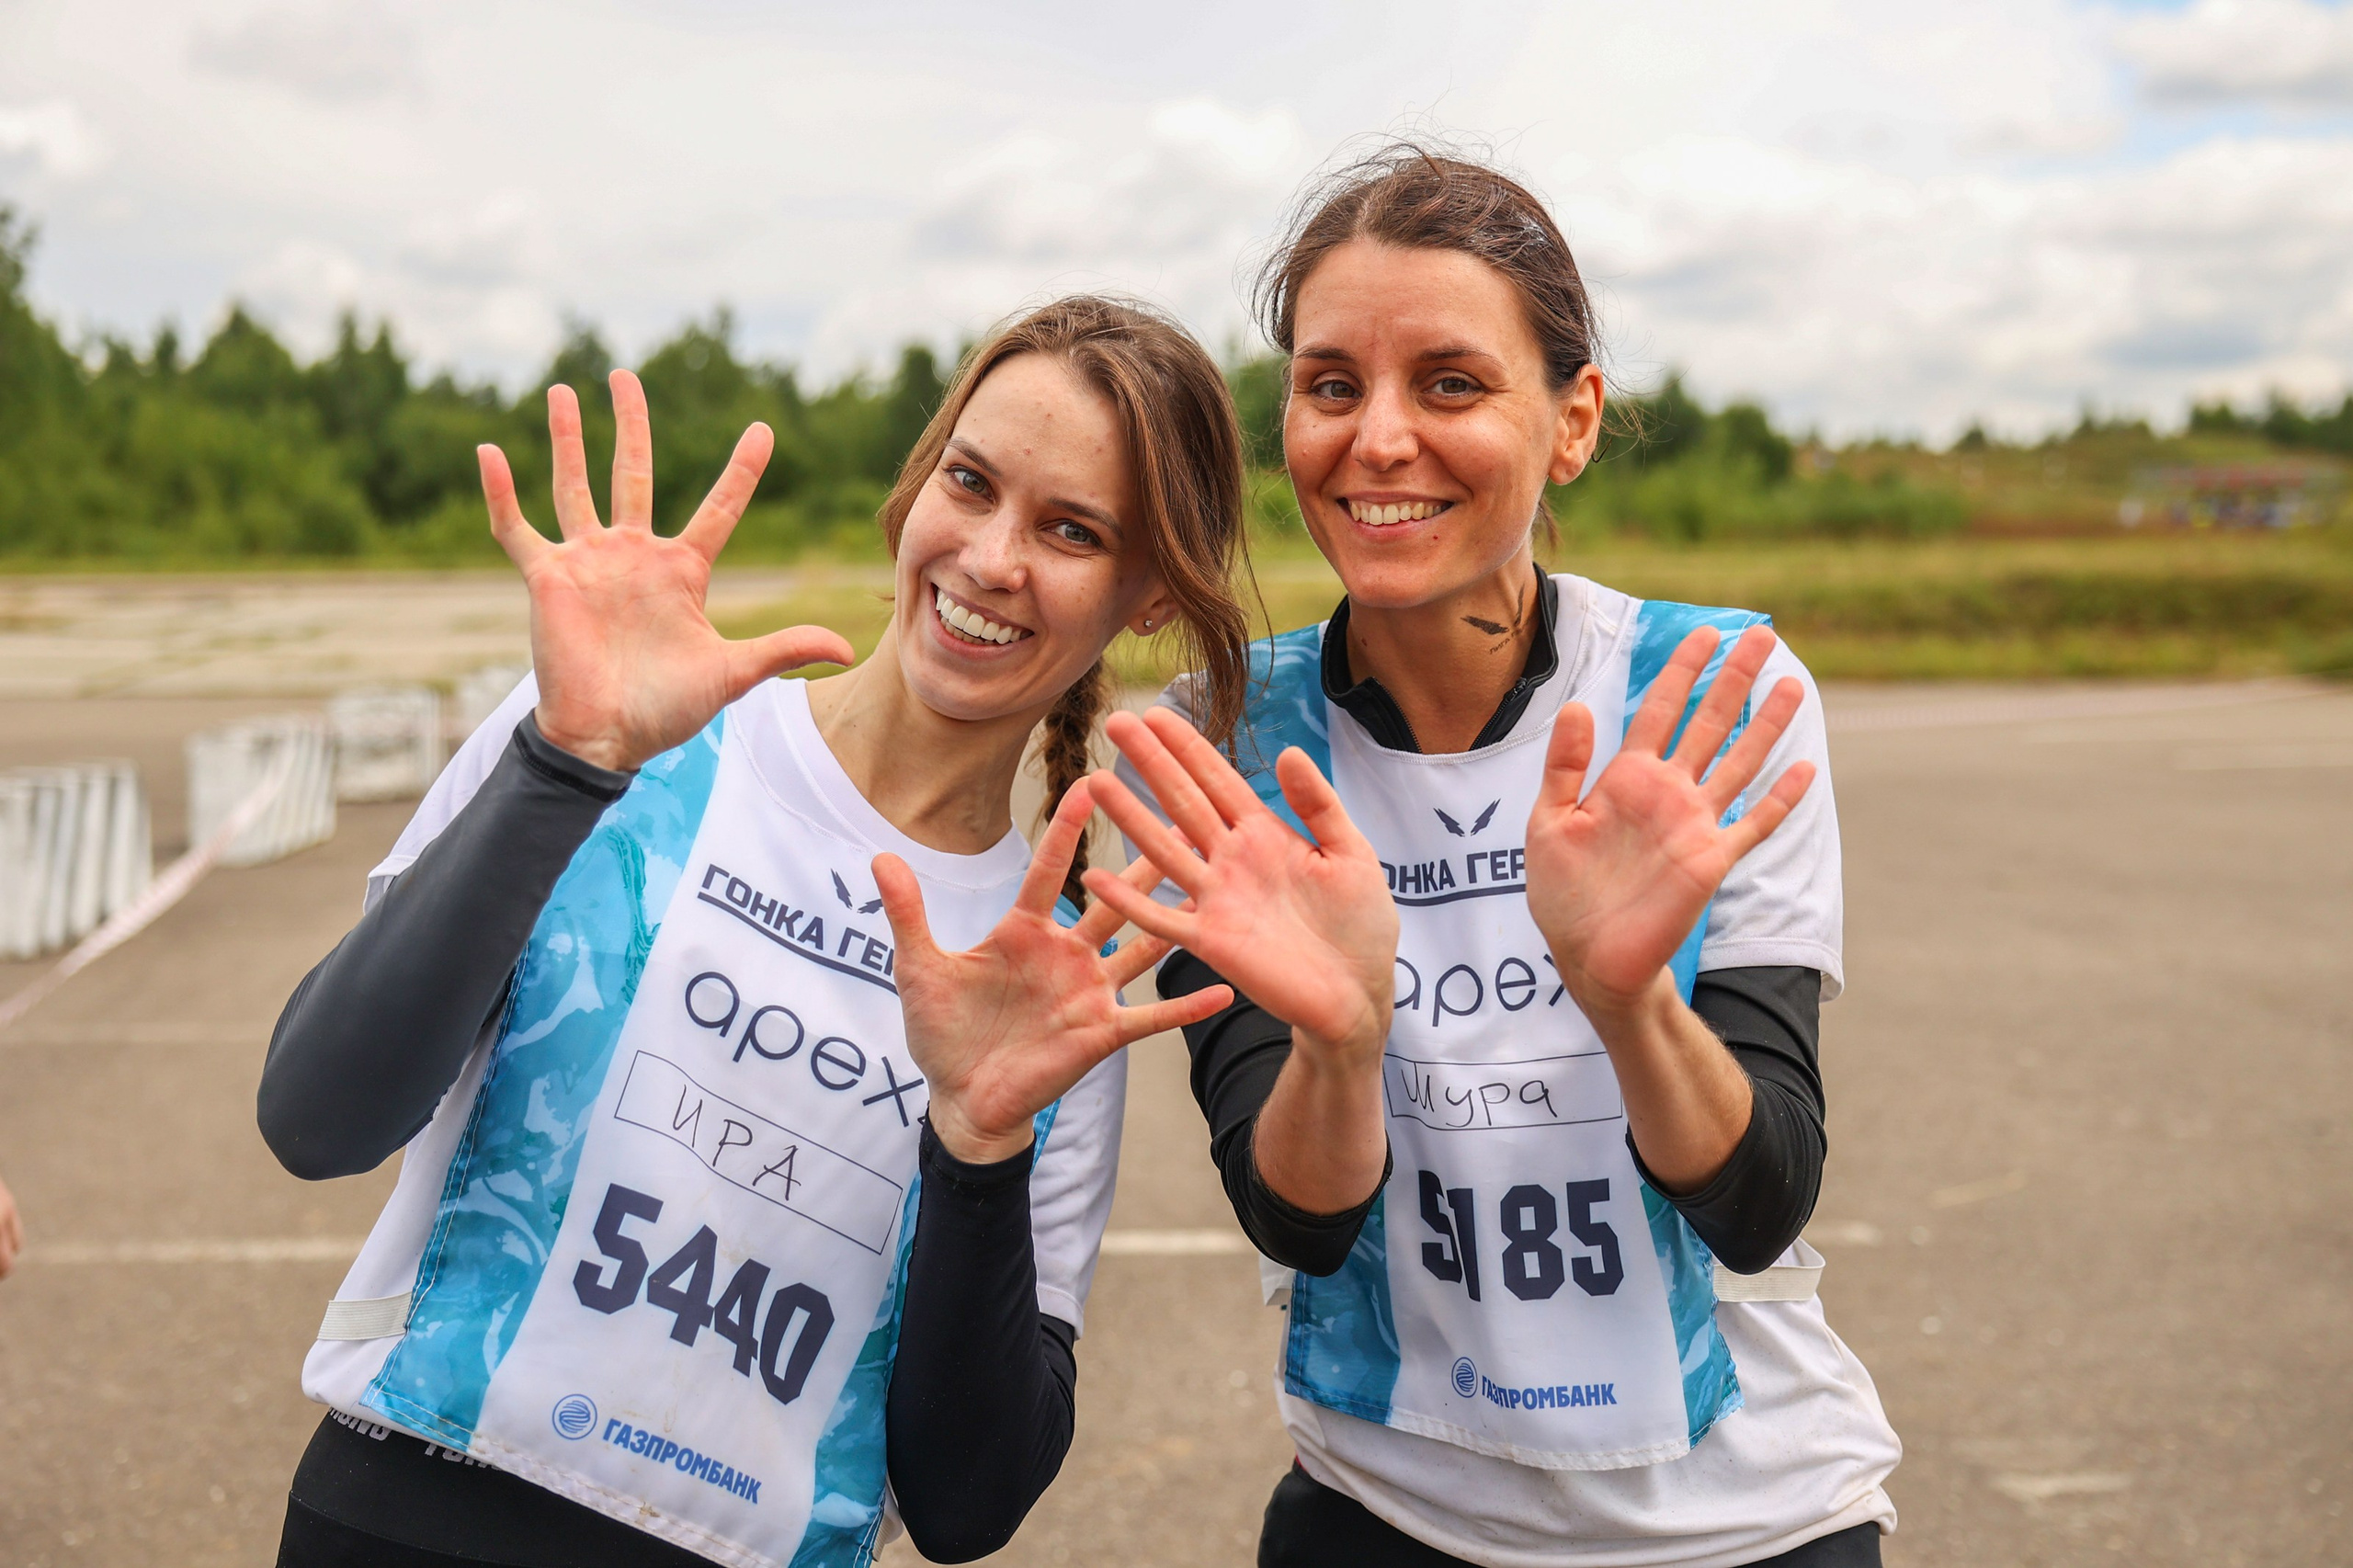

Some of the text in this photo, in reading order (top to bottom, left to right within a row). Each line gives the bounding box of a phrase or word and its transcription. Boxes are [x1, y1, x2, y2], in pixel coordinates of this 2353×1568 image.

[700, 863, 825, 951] ГОНКА
[1379, 847, 1526, 894] ОНКА ГЕР
[685, 971, 925, 1129] apex
[672, 1084, 802, 1201] ИРА
[572, 1182, 835, 1406] 5440
[1481, 1375, 1618, 1410] ГАЗПРОМБАНК
[601, 1418, 762, 1505] ГАЗПРОМБАНК
